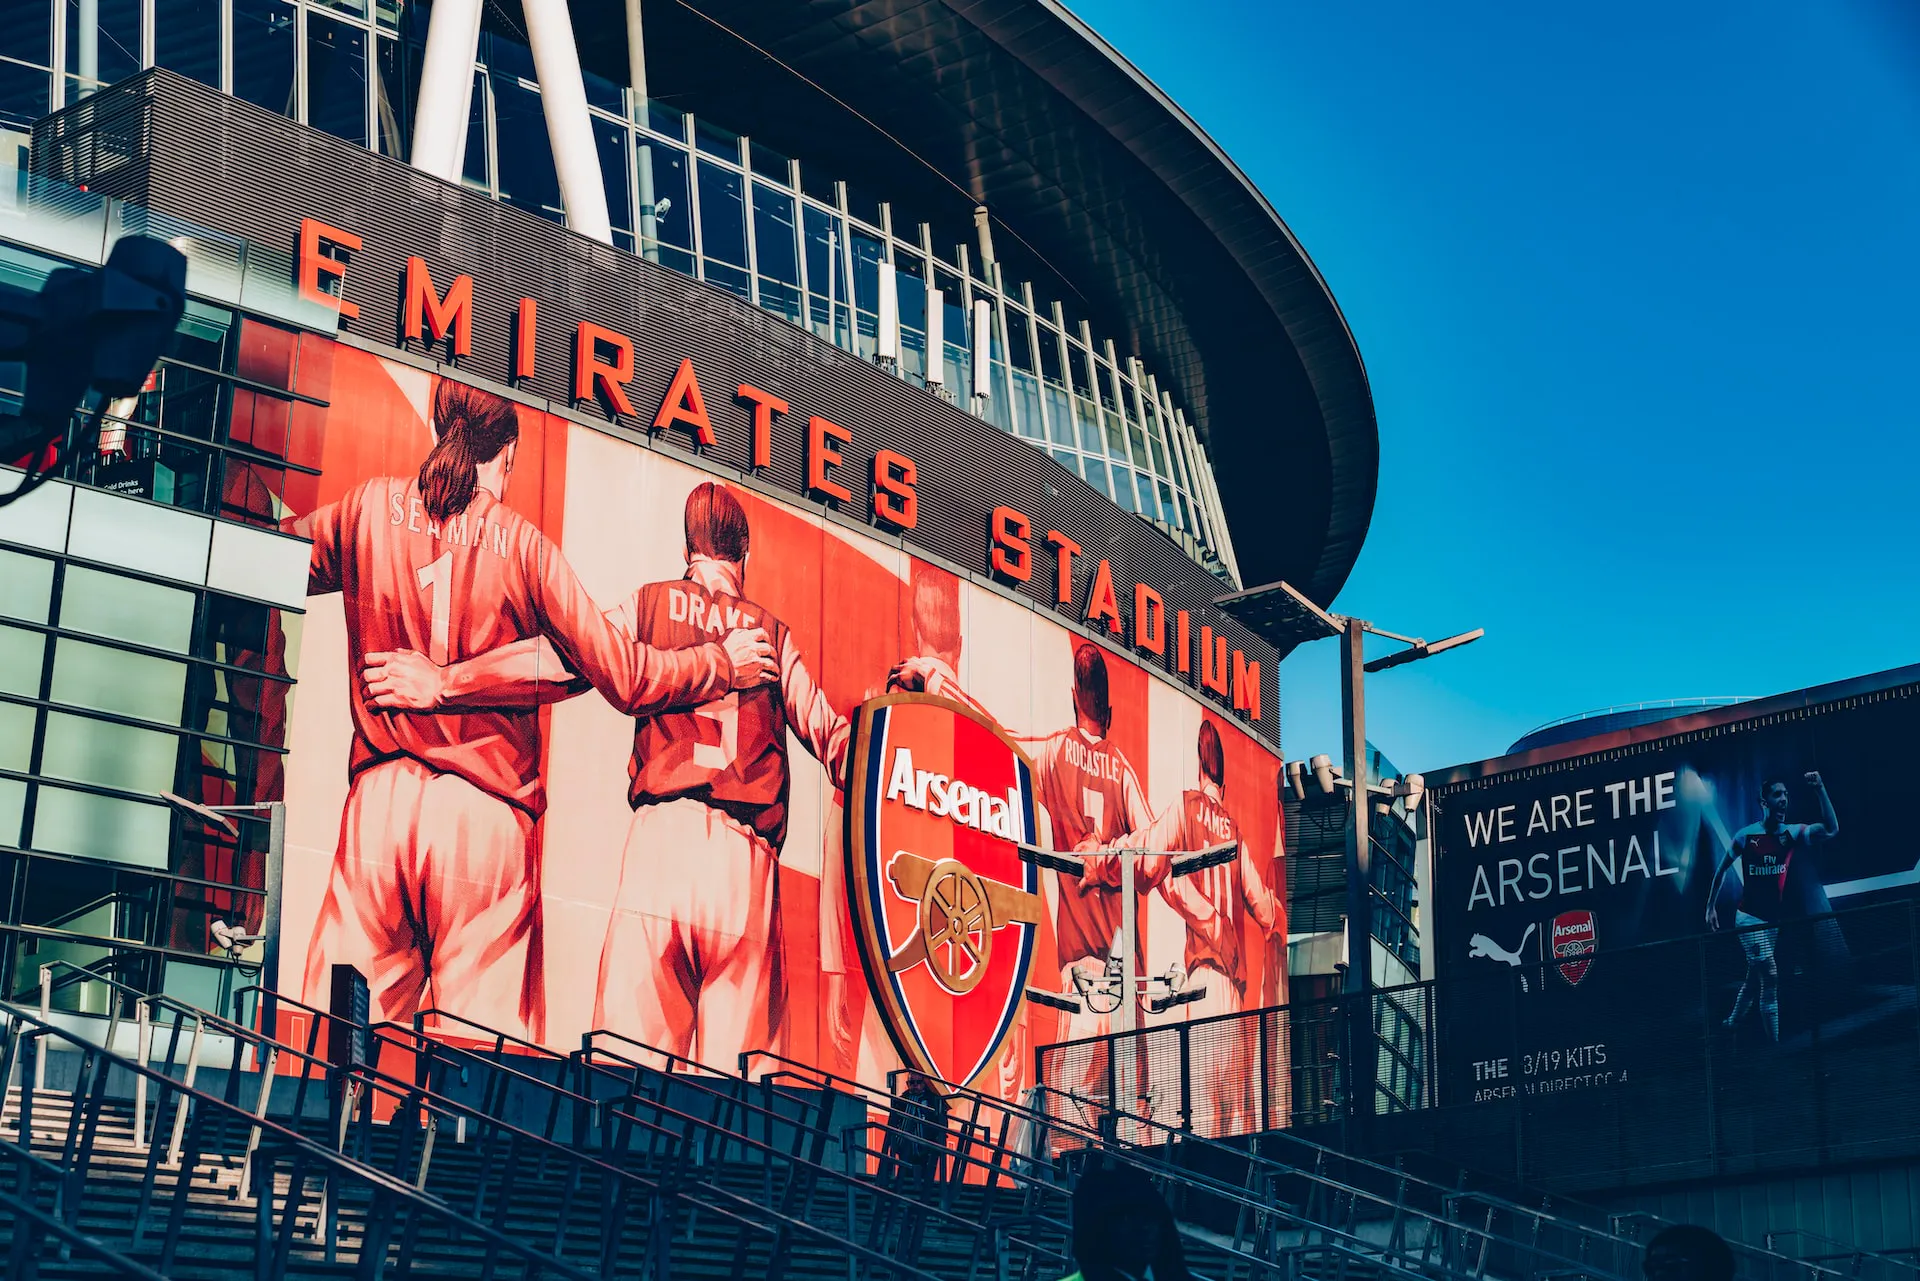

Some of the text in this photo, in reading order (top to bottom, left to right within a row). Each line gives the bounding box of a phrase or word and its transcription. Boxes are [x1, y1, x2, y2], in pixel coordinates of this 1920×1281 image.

[300, 218, 1260, 720] EMIRATES STADIUM
[390, 493, 509, 560] SEAMAN
[416, 549, 454, 667] 1
[886, 747, 1021, 843] Arsenal
[1065, 738, 1120, 785] ROCASTLE
[1197, 802, 1231, 840] JAMES
[1464, 771, 1676, 847] WE ARE THE
[1467, 830, 1679, 911] ARSENAL
[1763, 855, 1777, 864] Fly
[1554, 919, 1592, 937] Arsenal
[1472, 1058, 1509, 1081] THE
[1566, 1044, 1607, 1069] KITS
